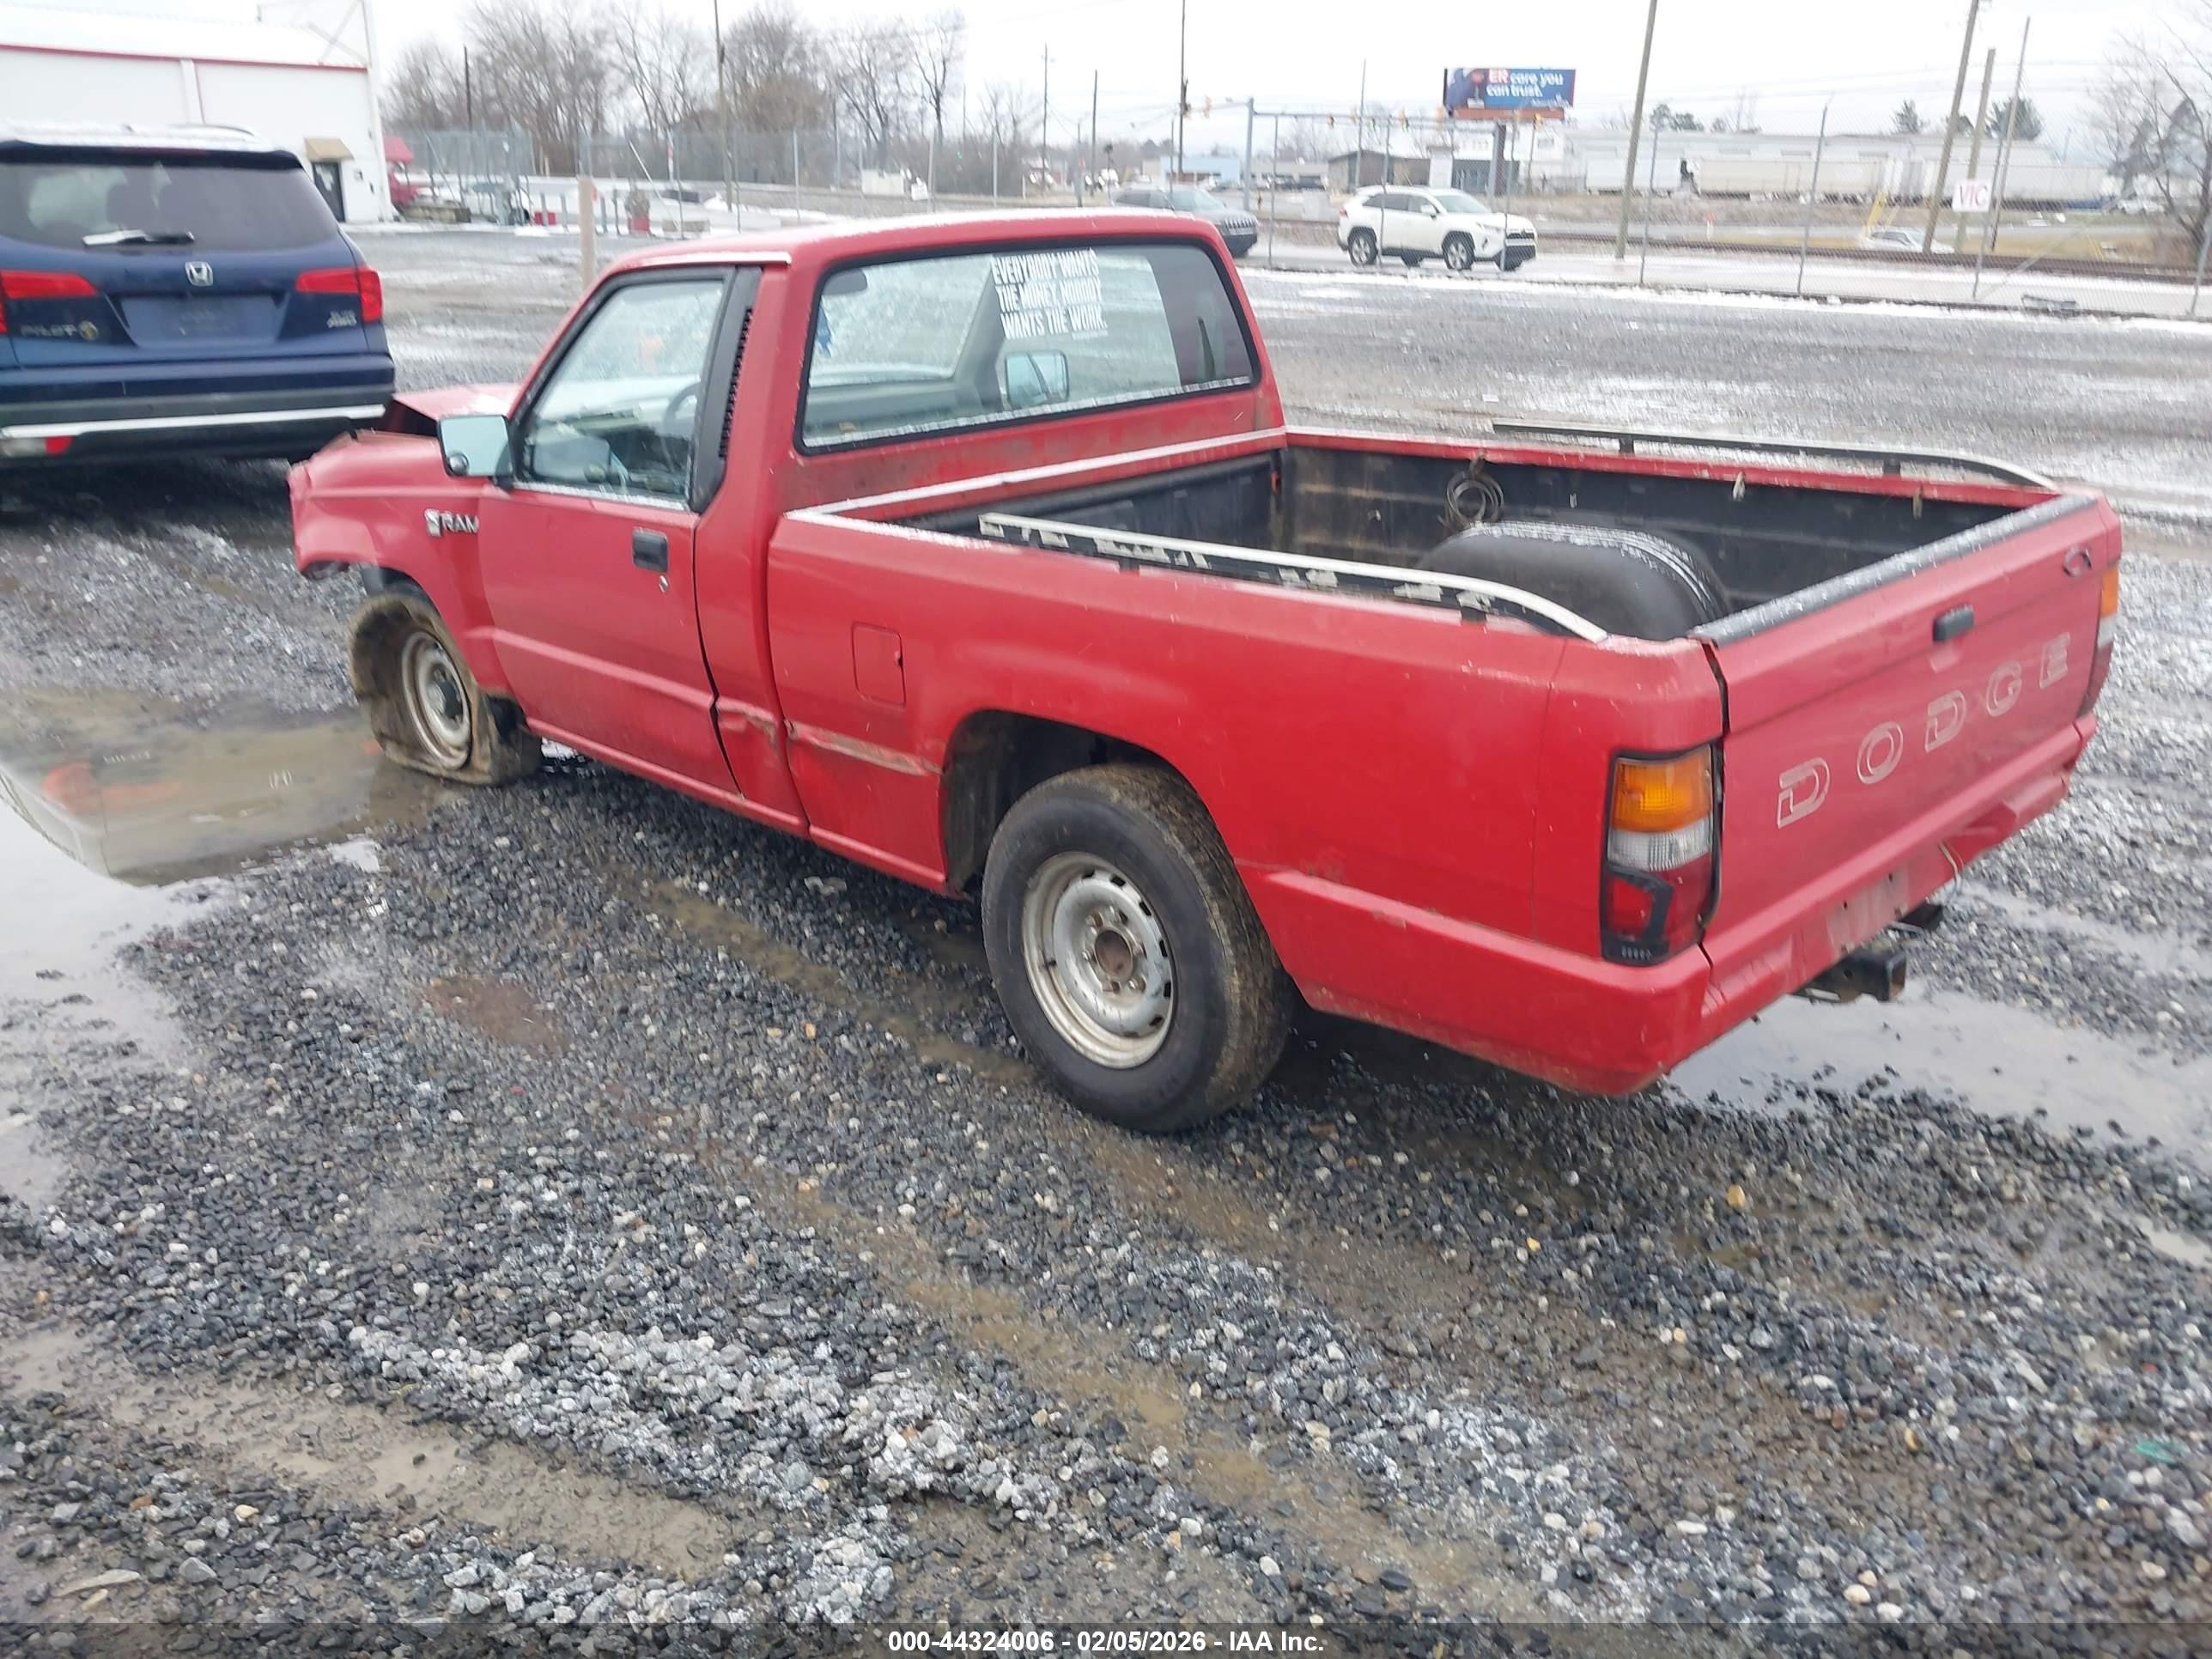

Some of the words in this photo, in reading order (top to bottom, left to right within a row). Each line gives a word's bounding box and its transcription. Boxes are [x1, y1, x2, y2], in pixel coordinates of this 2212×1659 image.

[1486, 85, 1509, 96] can
[1488, 69, 1509, 83] ER
[1510, 73, 1537, 85] care
[1540, 72, 1564, 88] you
[990, 252, 1057, 285] EVERYBODY
[1056, 247, 1100, 277] WANTS
[994, 283, 1020, 313] THE
[1059, 276, 1103, 305] NOBODY
[1000, 310, 1045, 340] WANTS
[1044, 307, 1069, 335] THE
[441, 510, 479, 533] RAM
[1777, 632, 2070, 830] DODGE
